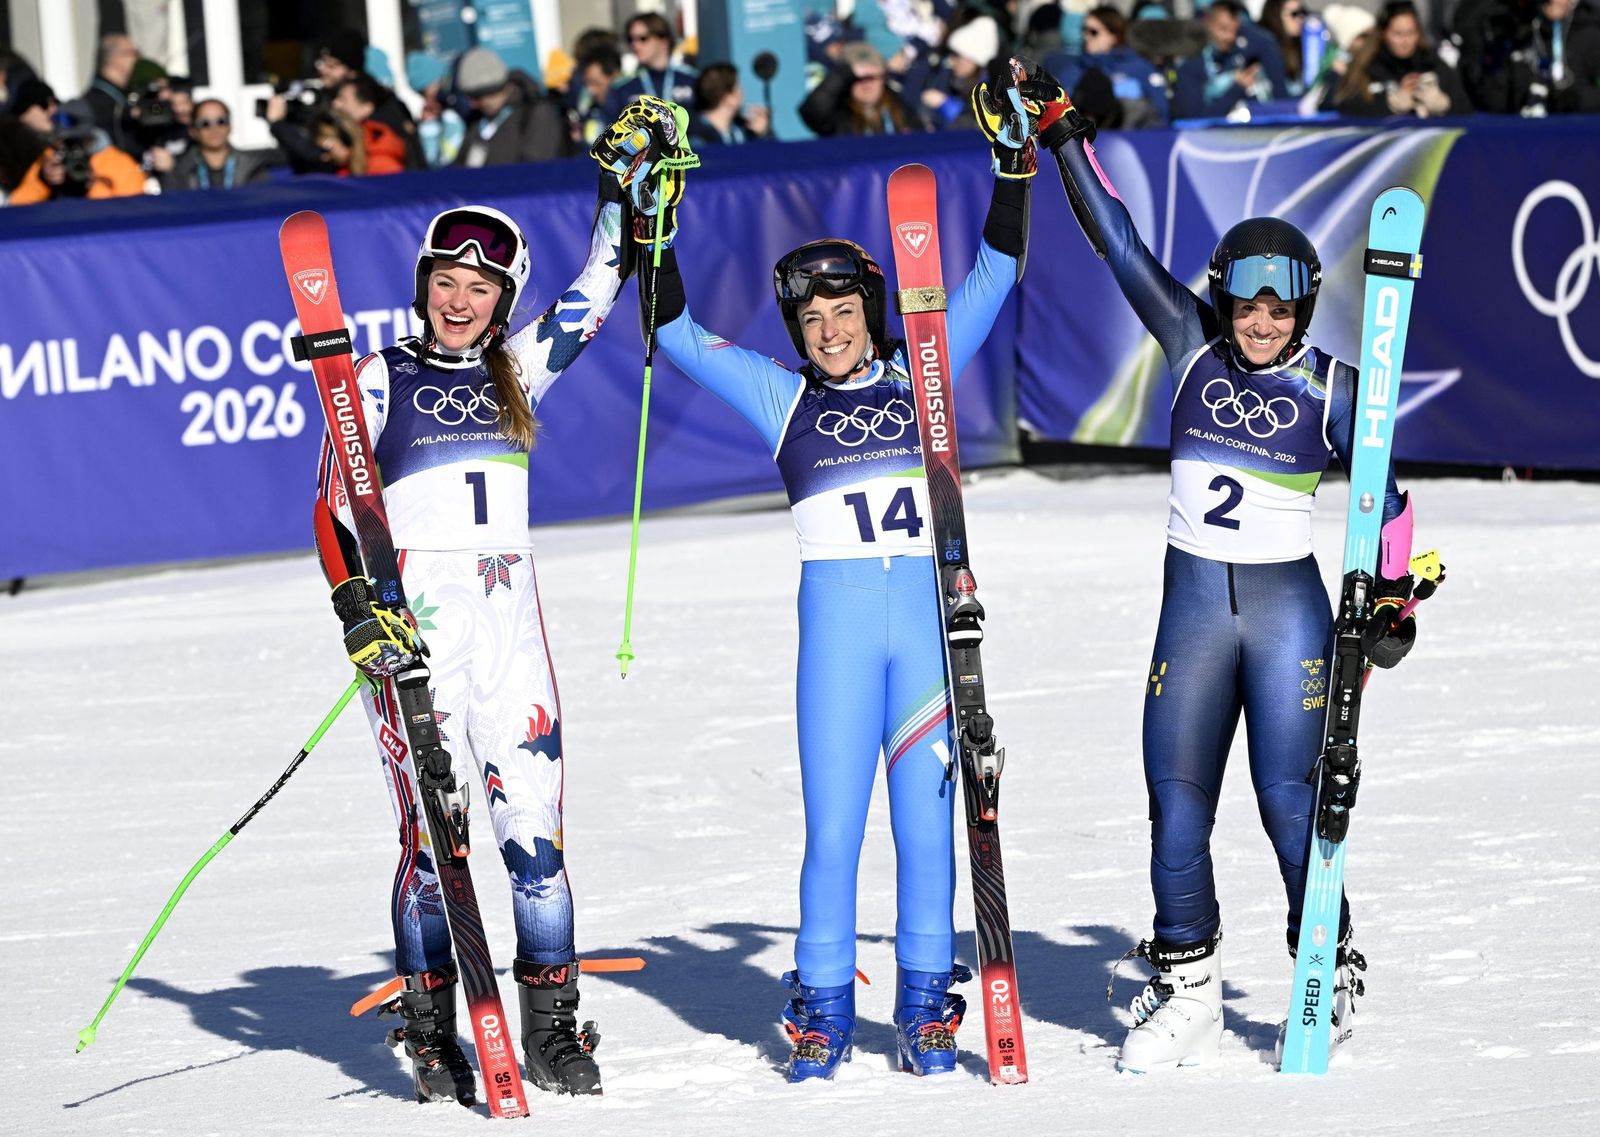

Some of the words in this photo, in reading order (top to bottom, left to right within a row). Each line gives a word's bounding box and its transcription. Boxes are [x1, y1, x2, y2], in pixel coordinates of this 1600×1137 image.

[1371, 258, 1404, 267] HEAD
[313, 336, 349, 348] ROSSIGNOL
[1362, 286, 1400, 448] HEAD
[919, 335, 949, 452] ROSSIGNOL
[180, 382, 306, 447] 2026
[330, 379, 373, 497] ROSSIGNOL
[411, 433, 459, 447] MILANO
[1185, 427, 1224, 444] MILANO
[1225, 438, 1271, 458] CORTINA
[1273, 451, 1297, 464] 2026
[813, 454, 861, 468] MILANO
[863, 447, 912, 461] CORTINA
[465, 472, 488, 525] 1
[1203, 474, 1244, 531] 2
[843, 486, 923, 543] 14
[945, 550, 961, 560] GS
[383, 591, 398, 602] GS
[1302, 695, 1326, 711] SWE
[1158, 946, 1206, 960] HEAD
[1302, 978, 1321, 1027] SPEED
[998, 1038, 1014, 1049] GS
[495, 1071, 511, 1084] GS
